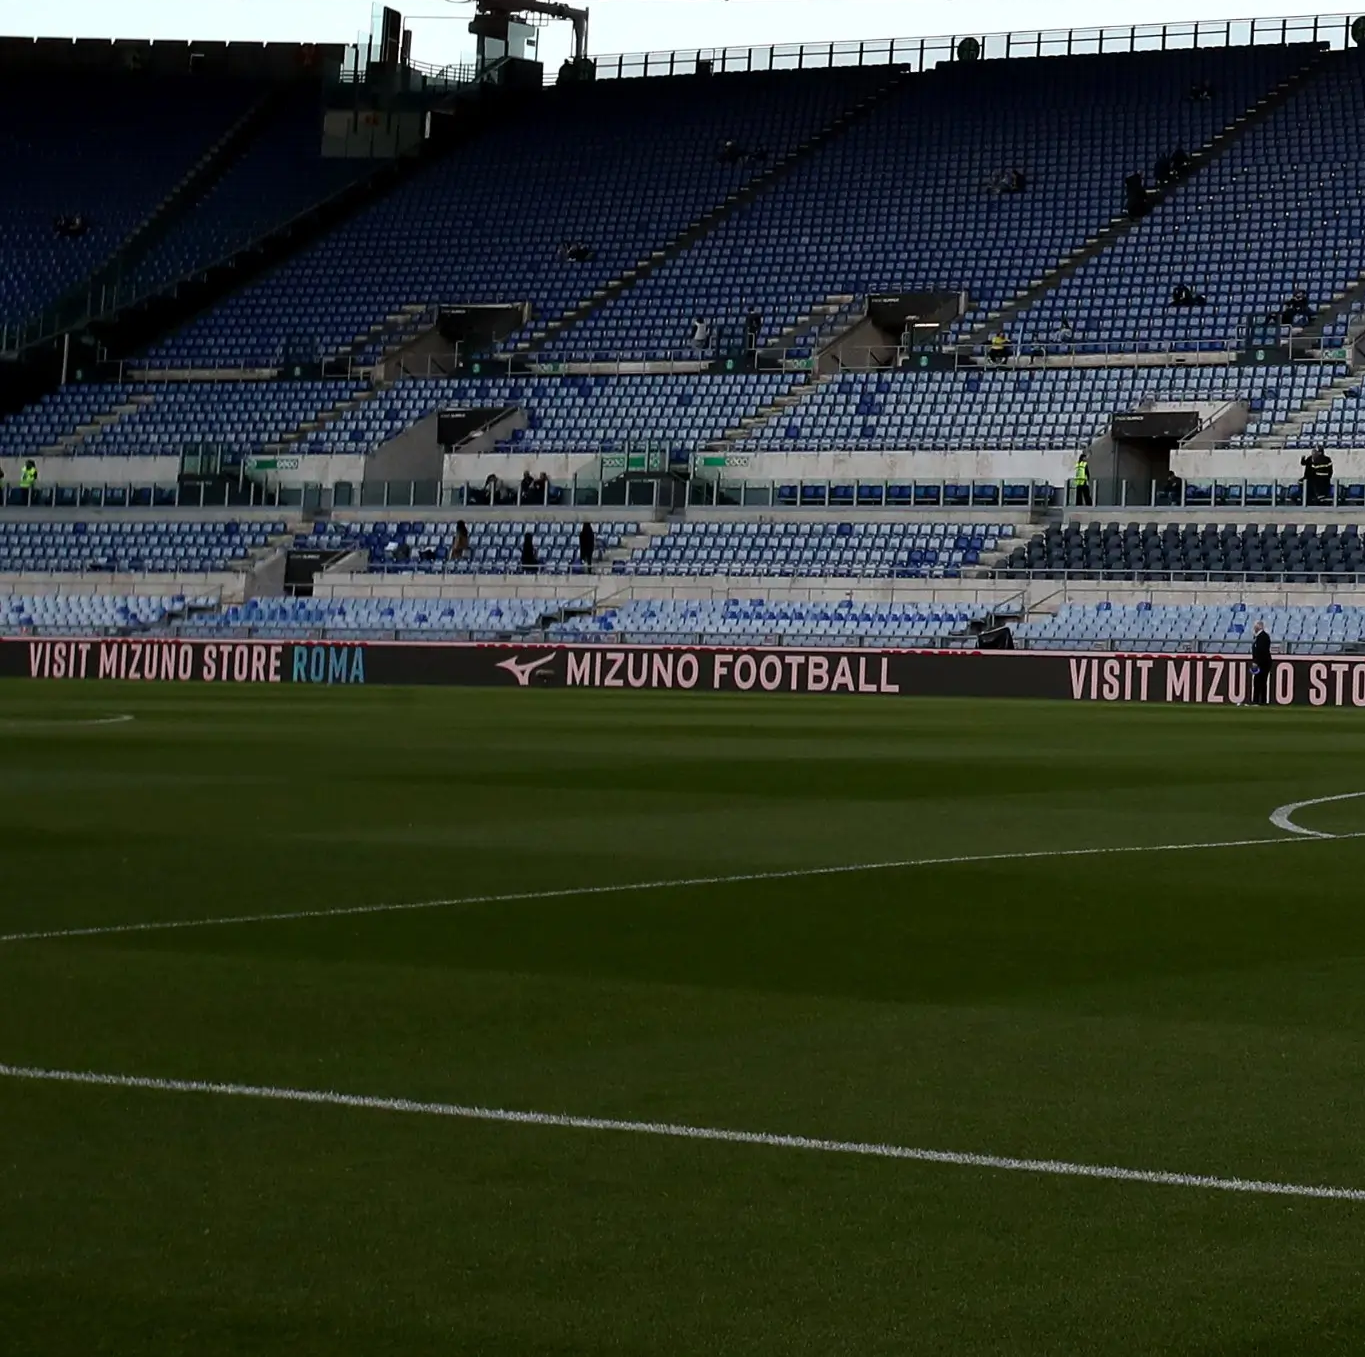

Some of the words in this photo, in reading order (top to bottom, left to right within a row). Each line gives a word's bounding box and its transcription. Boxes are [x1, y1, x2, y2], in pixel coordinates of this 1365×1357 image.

[30, 642, 90, 679] VISIT
[99, 643, 192, 680] MIZUNO
[203, 645, 282, 682] STORE
[293, 646, 364, 683] ROMA
[567, 652, 699, 689] MIZUNO
[714, 654, 900, 693] FOOTBALL
[1070, 658, 1152, 701] VISIT
[1166, 660, 1294, 705] MIZUO
